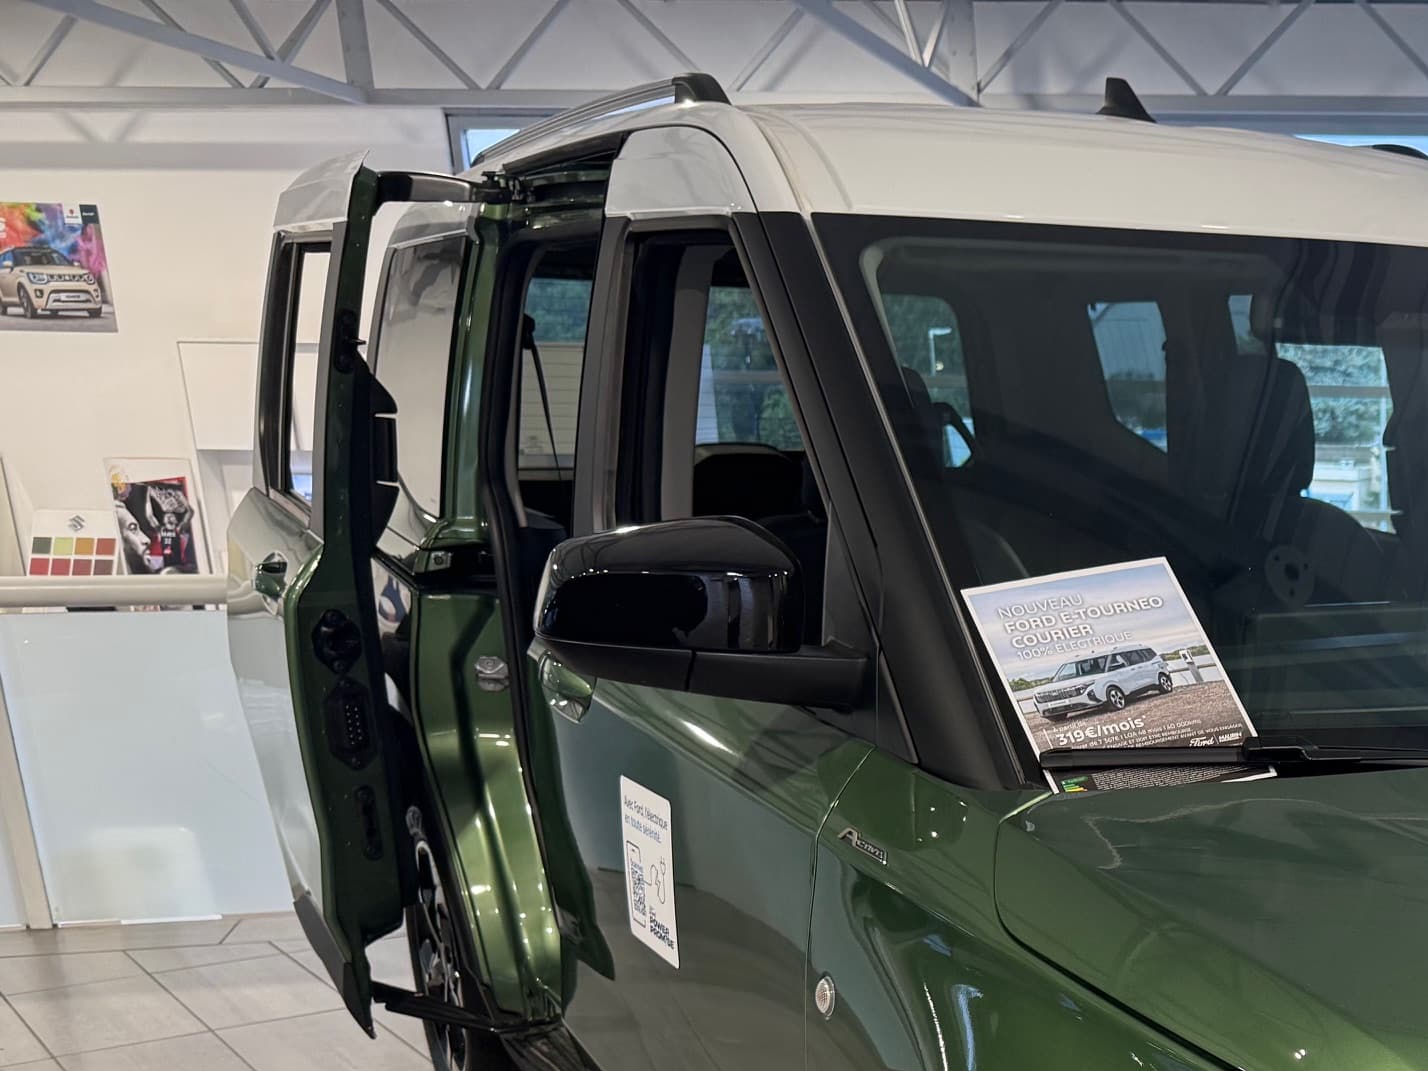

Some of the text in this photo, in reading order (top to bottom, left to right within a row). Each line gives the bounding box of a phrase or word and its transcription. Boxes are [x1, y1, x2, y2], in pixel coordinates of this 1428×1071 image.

[998, 593, 1083, 620] NOUVEAU
[1004, 596, 1164, 635] FORD E-TOURNEO
[1011, 624, 1094, 650] COURIER
[1017, 646, 1054, 661] 100%
[1189, 736, 1215, 748] Ford
